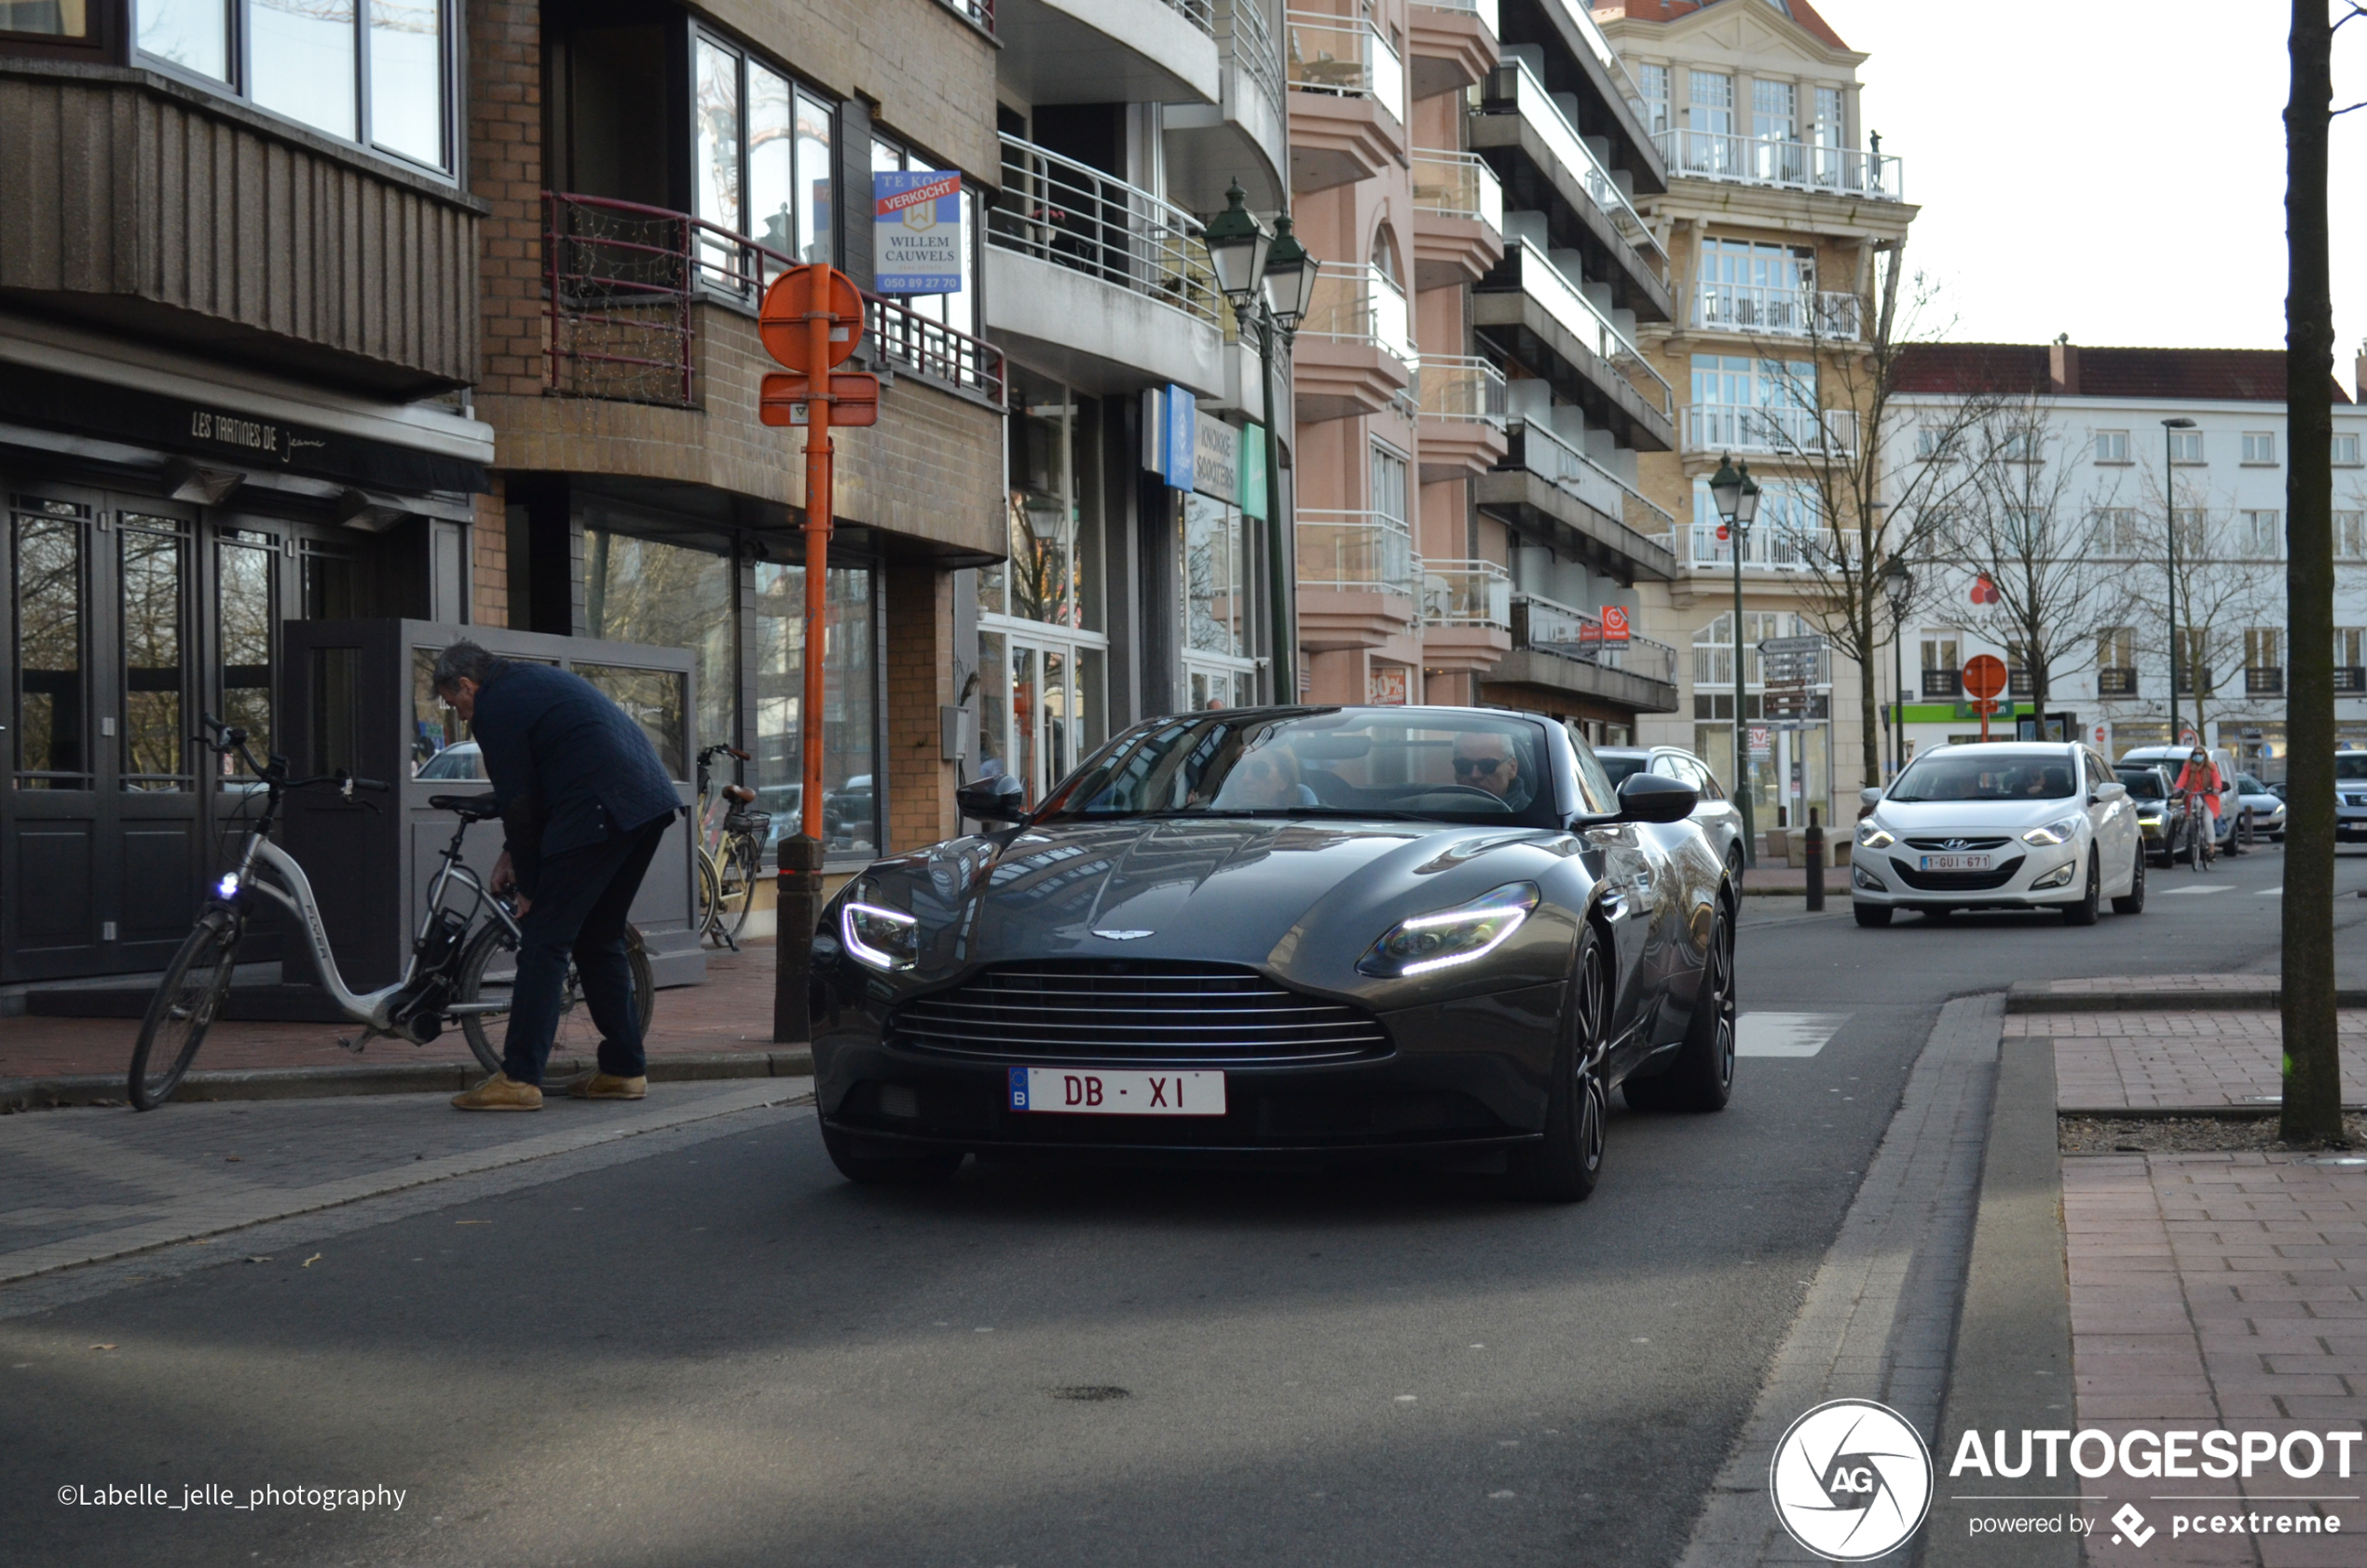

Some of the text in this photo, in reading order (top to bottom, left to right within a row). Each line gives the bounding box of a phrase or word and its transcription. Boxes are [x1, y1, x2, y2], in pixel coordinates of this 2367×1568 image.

[882, 175, 904, 187] TE
[884, 181, 951, 211] VERKOCHT
[890, 236, 949, 248] WILLEM
[885, 251, 954, 262] CAUWELS
[884, 278, 957, 288] 050 89 27 70
[192, 411, 212, 439] LES
[215, 415, 261, 448] TARTINES
[263, 425, 277, 451] DE
[1201, 423, 1231, 457] KNOKKE
[1197, 454, 1234, 489] SCOOTERS
[1769, 640, 1810, 649] Knokke-Dorp
